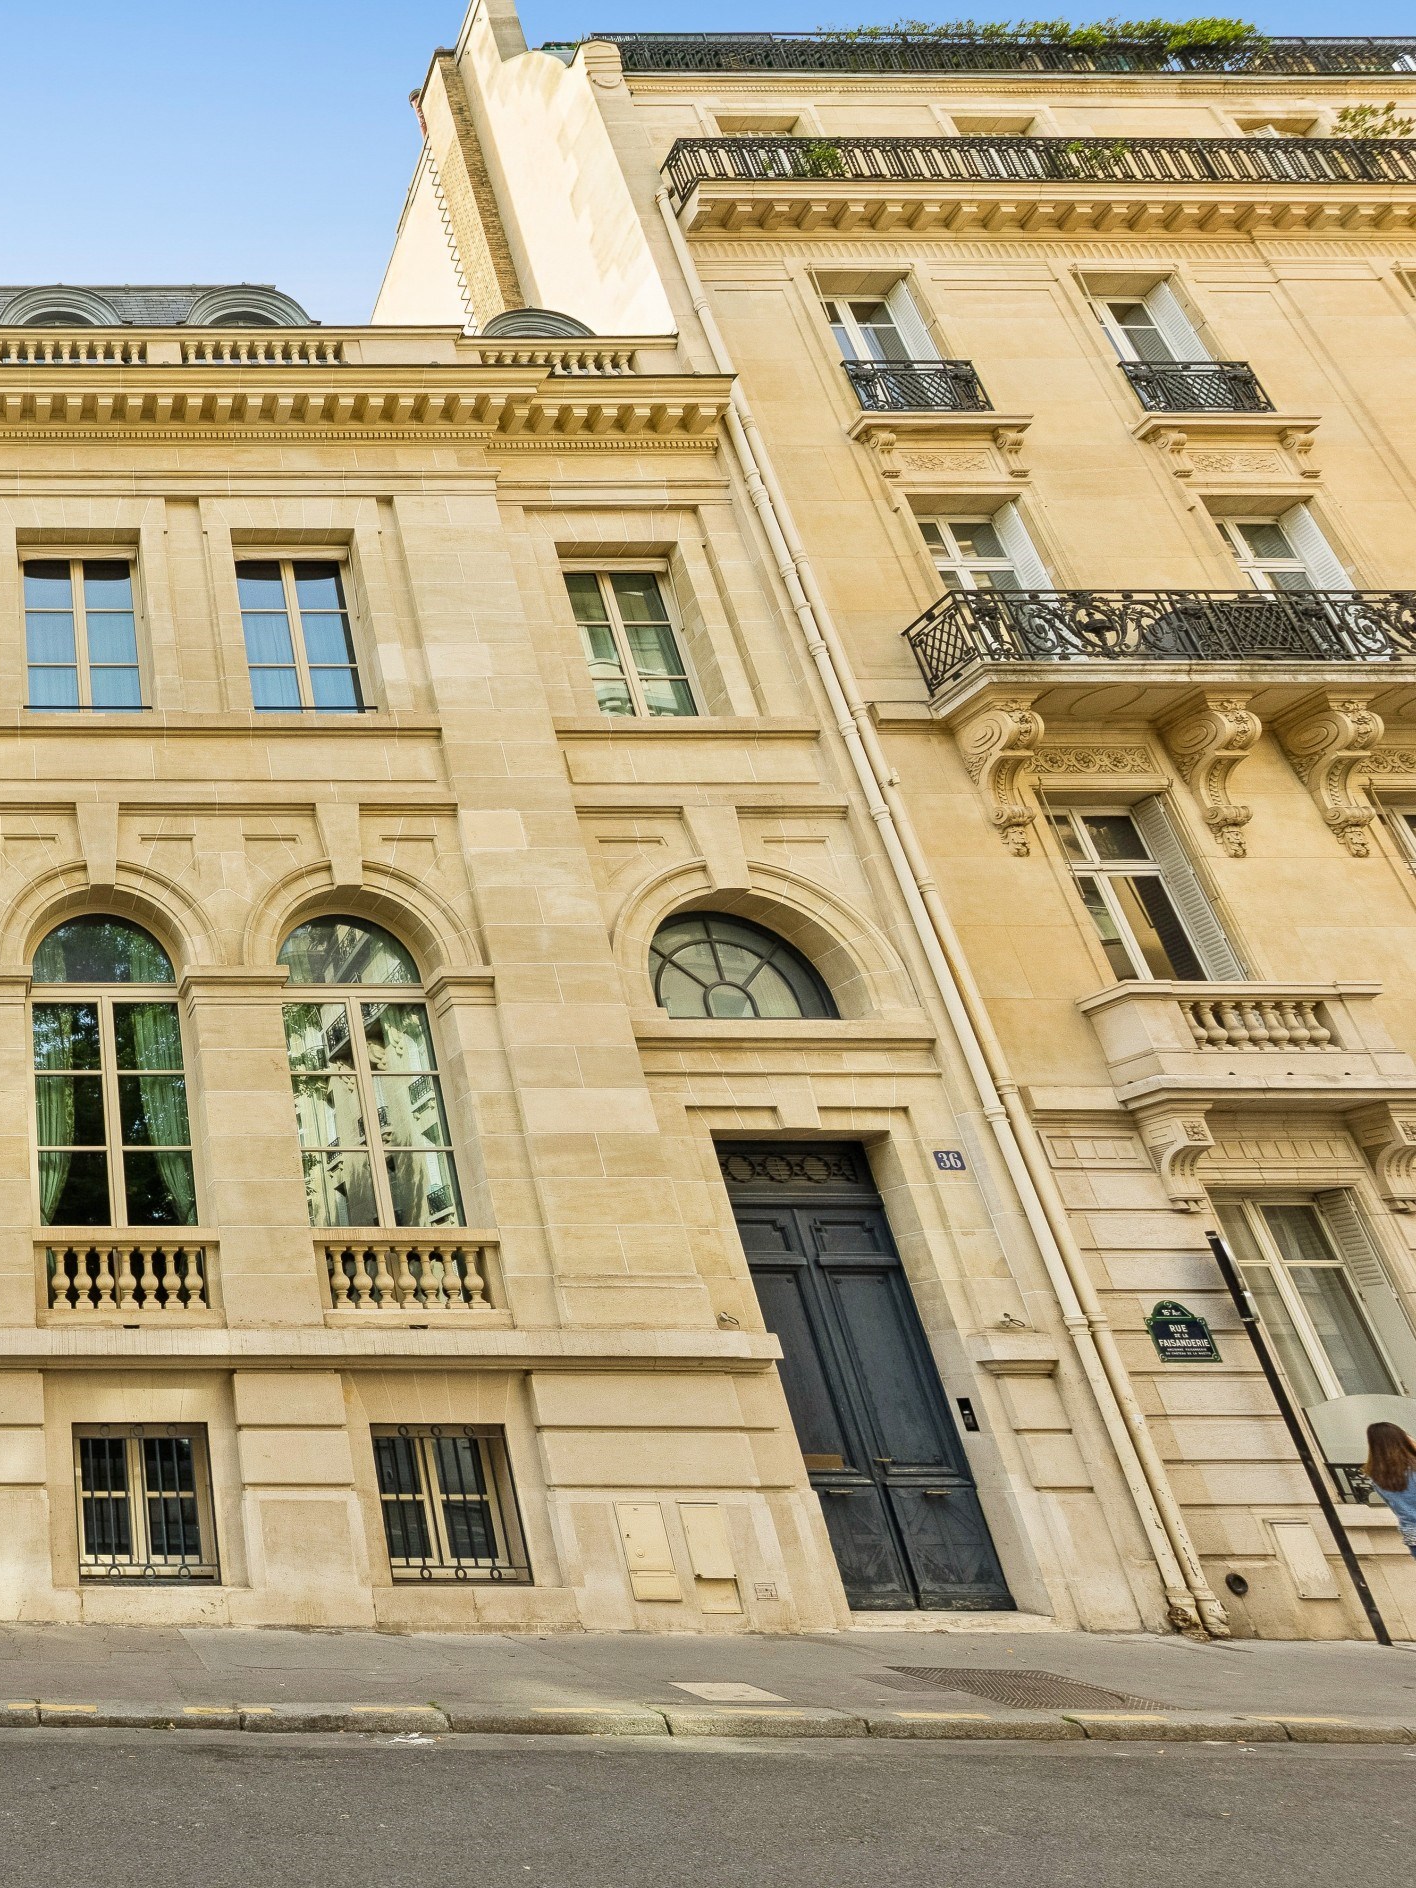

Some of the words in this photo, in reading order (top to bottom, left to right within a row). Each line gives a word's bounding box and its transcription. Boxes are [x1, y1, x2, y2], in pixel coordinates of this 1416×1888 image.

[937, 1152, 962, 1169] 36
[1168, 1324, 1189, 1333] RUE
[1158, 1339, 1211, 1347] FAISANDERIE
